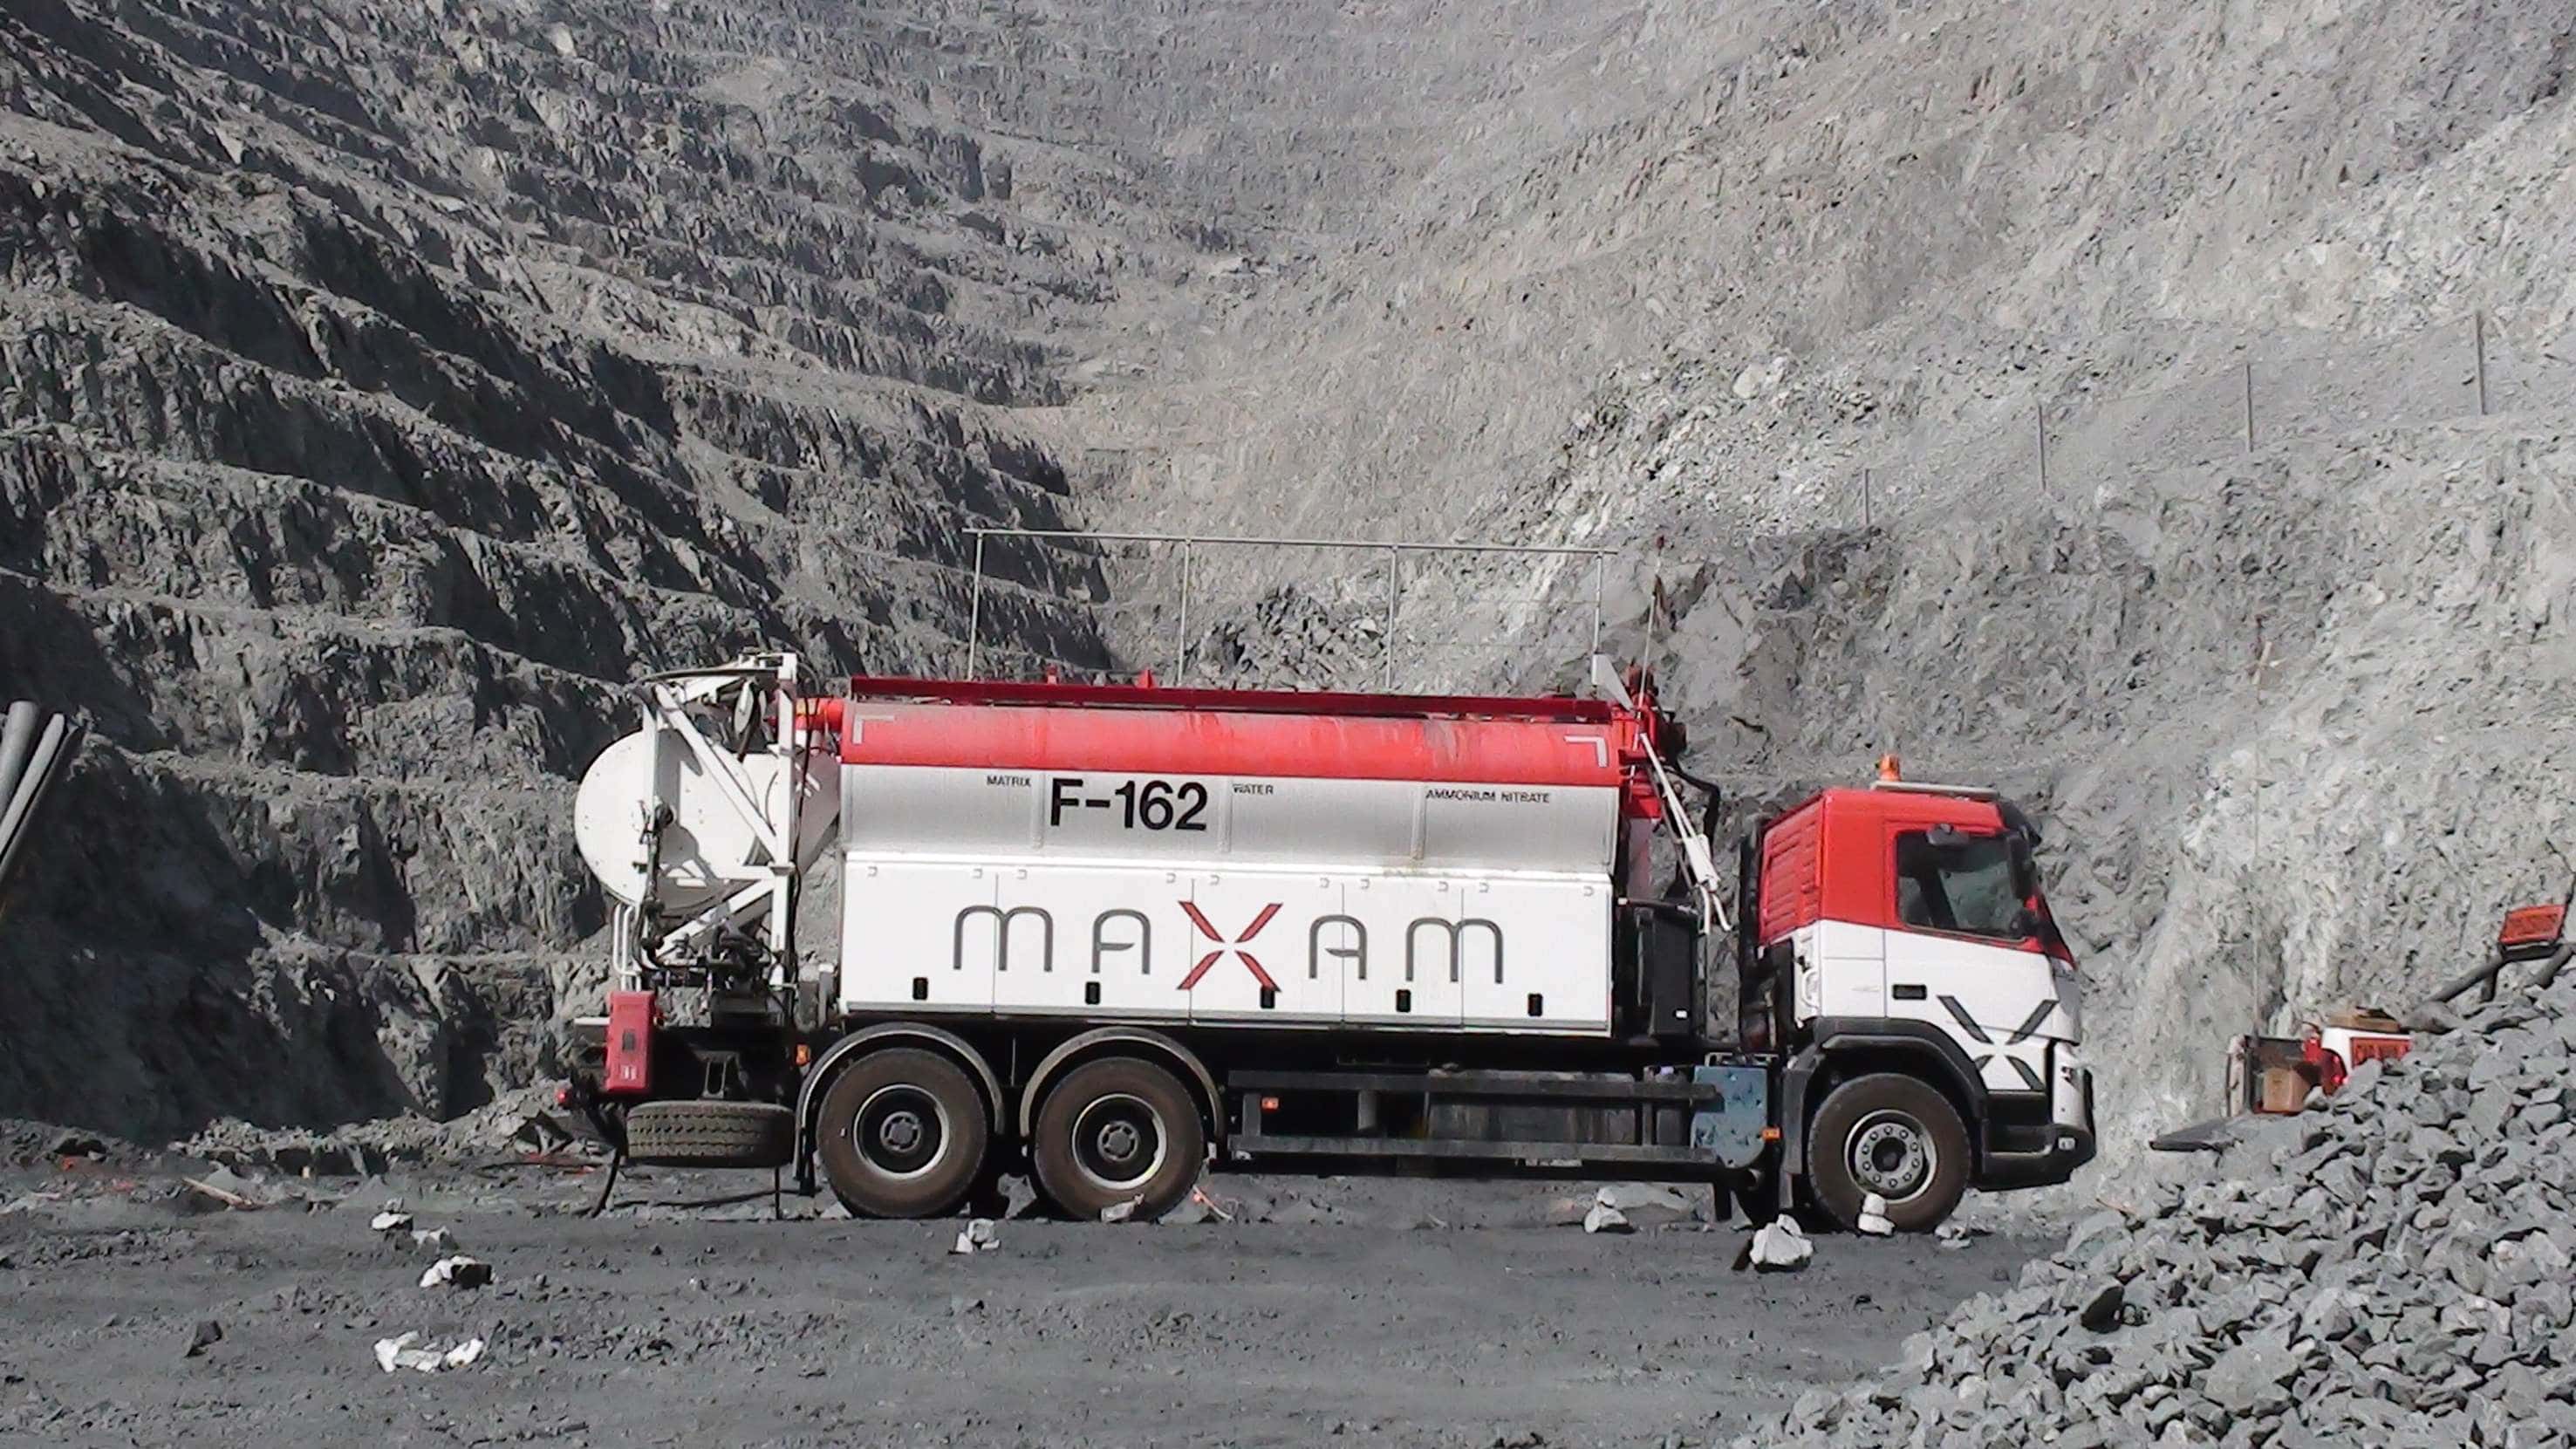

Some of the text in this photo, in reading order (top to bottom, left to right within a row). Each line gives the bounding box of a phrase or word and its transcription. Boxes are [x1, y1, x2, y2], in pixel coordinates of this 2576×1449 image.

[987, 775, 1031, 787] MATRIX
[1233, 783, 1274, 795] WATER
[1425, 789, 1550, 803] AMMONIUM NITRATE
[1050, 777, 1208, 830] F-162
